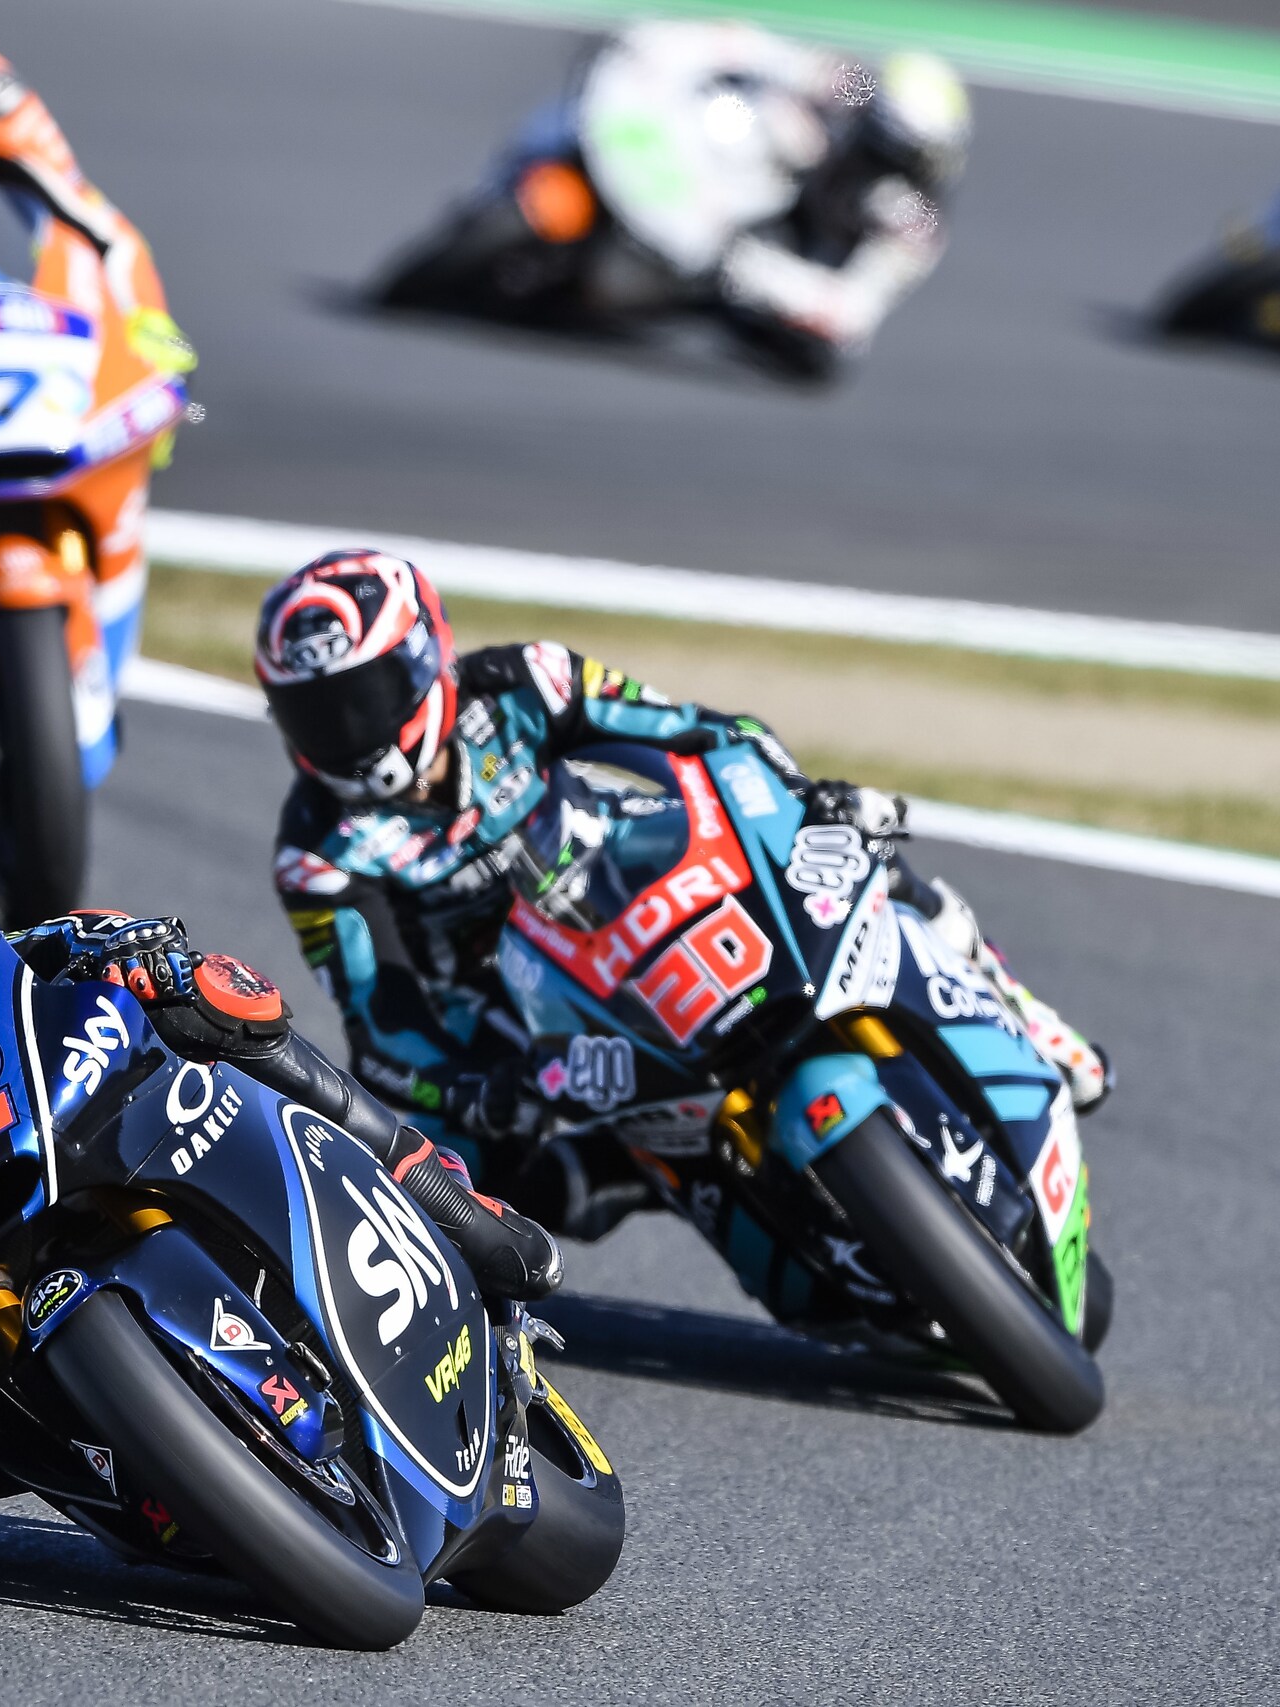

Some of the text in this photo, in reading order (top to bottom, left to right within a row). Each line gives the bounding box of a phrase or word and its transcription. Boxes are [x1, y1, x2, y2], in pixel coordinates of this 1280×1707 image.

[63, 995, 130, 1097] sky
[170, 1084, 244, 1176] OAKLEY
[303, 1124, 334, 1172] RACING
[341, 1166, 459, 1346] sky
[455, 1427, 480, 1473] TEAM
